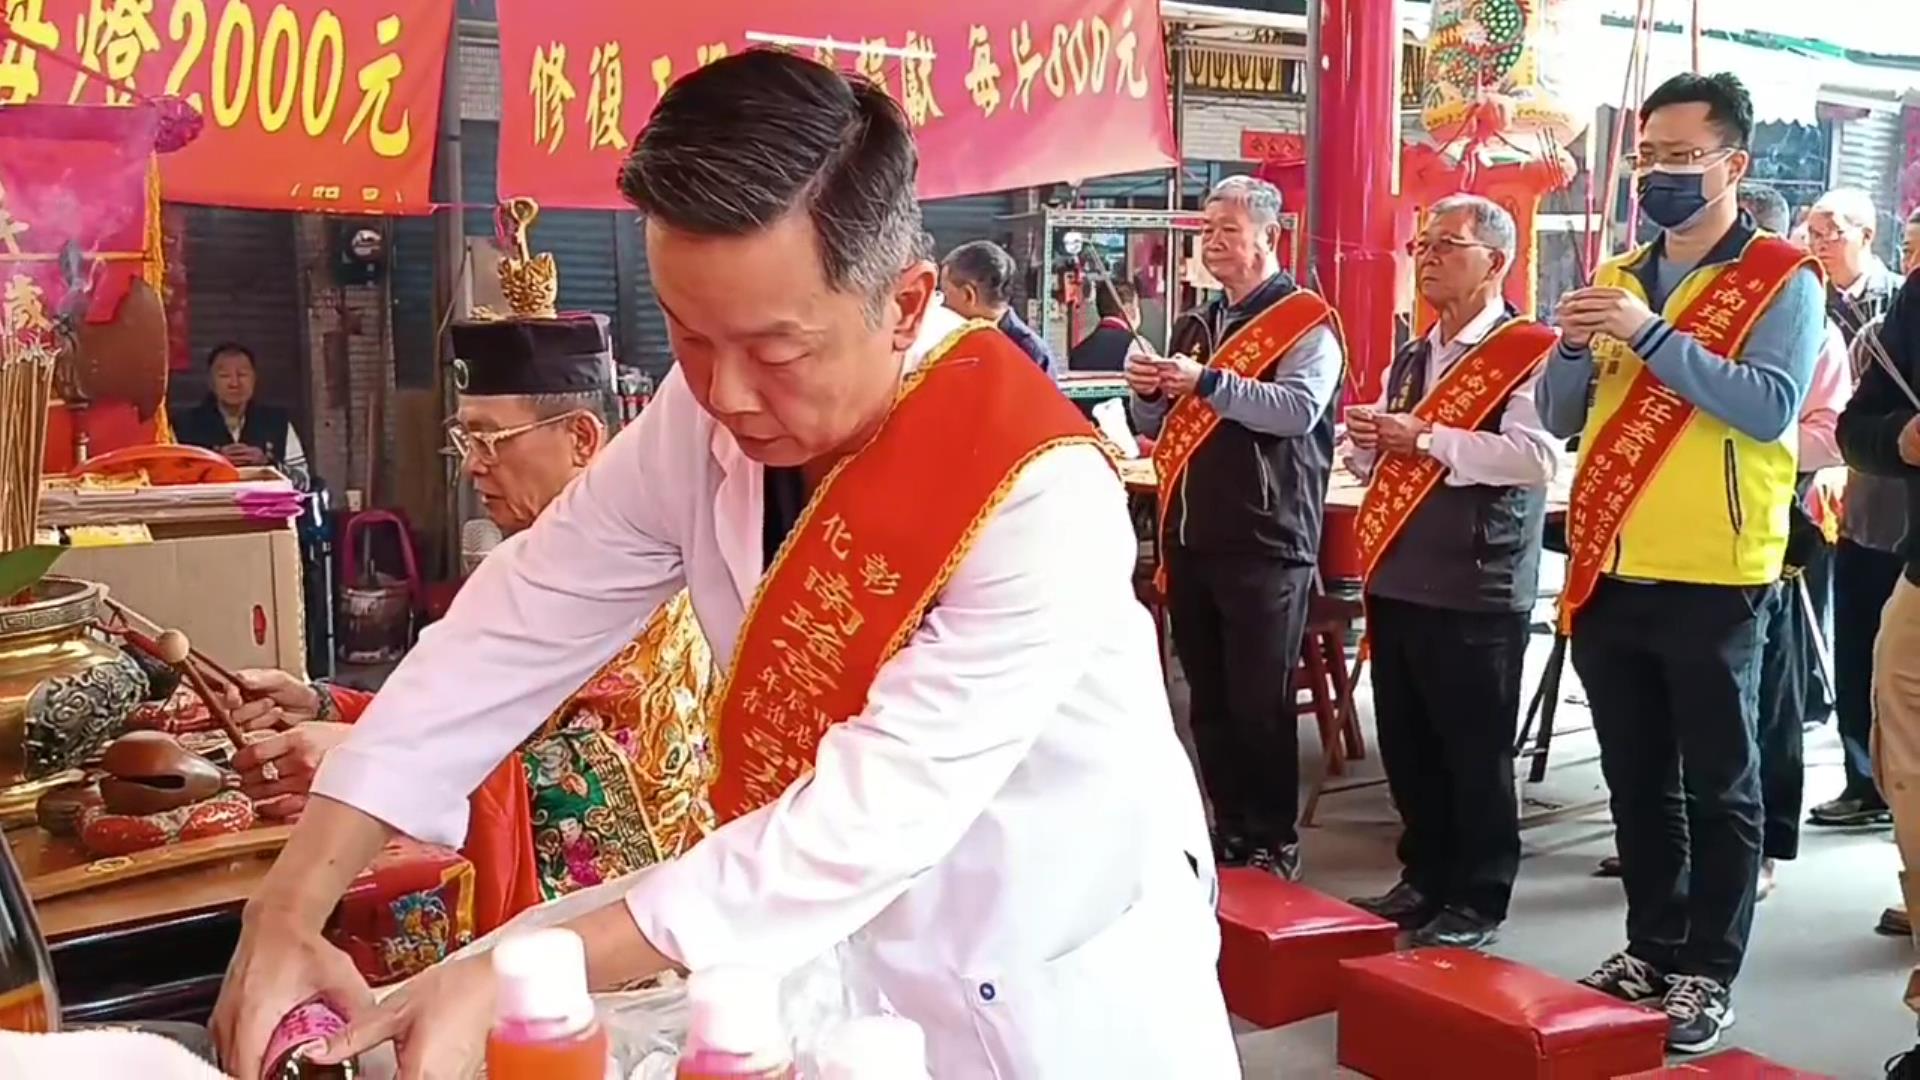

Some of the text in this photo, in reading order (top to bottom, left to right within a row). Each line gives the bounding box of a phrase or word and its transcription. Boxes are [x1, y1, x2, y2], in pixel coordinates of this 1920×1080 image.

[820, 512, 902, 597] 彰化
[771, 564, 866, 697] 南瑤宮
